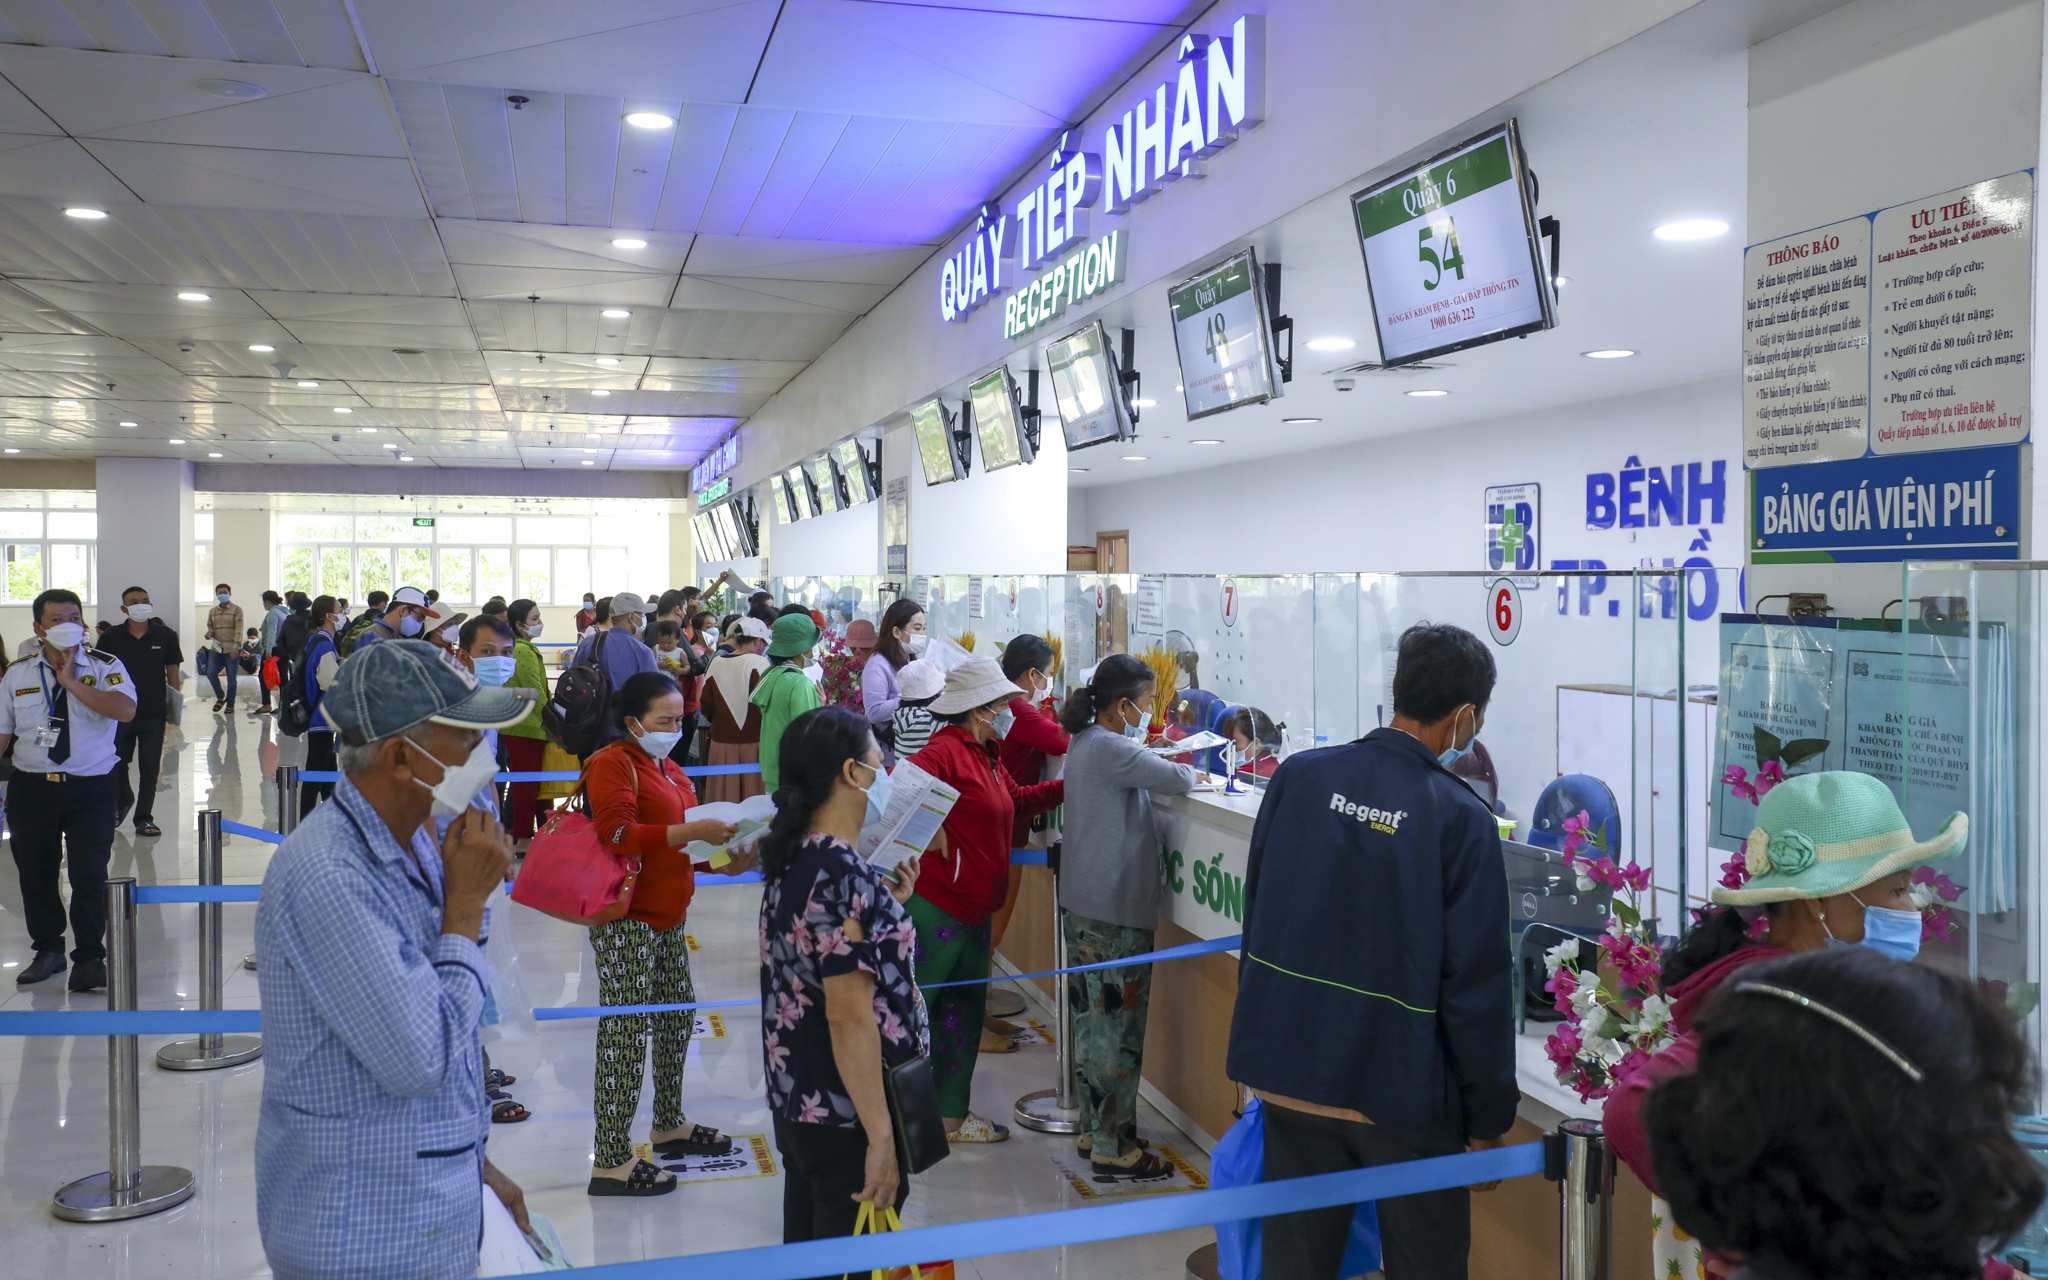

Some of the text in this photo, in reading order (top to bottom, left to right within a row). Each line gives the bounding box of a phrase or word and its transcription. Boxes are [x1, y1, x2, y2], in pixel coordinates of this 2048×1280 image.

[941, 14, 1246, 321] QUẦY TIẾP NHẬN
[1403, 169, 1457, 217] Quầy 6
[1911, 209, 1936, 229] ƯU
[1878, 253, 1894, 263] Luật
[1897, 249, 1918, 259] khám,
[1919, 243, 1938, 253] chữa
[1940, 236, 1958, 248] bệnh
[1961, 232, 1970, 243] số
[1909, 234, 1926, 244] Theo
[1929, 227, 1951, 239] khoản
[1954, 224, 1960, 233] 4,
[1419, 216, 1464, 291] 54
[1767, 235, 1839, 266] THÔNG BÁO
[1004, 230, 1118, 339] RECEPTION
[1892, 261, 1984, 288] Trường hợp cấp cứu;
[1195, 277, 1223, 310] Quầy 7
[1414, 303, 1432, 318] KHÁM
[1432, 298, 1450, 313] BỆNH
[1482, 281, 1506, 297] THÔNG
[1507, 277, 1520, 289] TIN
[1892, 284, 1976, 311] Trẻ em dưới 6 tuổi;
[1430, 306, 1476, 330] 1900 636 223
[1892, 309, 1994, 336] Người khuyết tật nặng;
[1206, 312, 1230, 364] 48
[1891, 330, 2013, 359] Người từ đủ 80 tuổi trở lên;
[1891, 354, 2025, 382] Người có công với cách mạng;
[1891, 386, 1956, 404] Phụ nữ có thai.
[1902, 400, 1995, 422] Trường hợp ưu tiên liên hệ
[1878, 413, 2022, 442] Quầy tiếp nhận số 1, 6, 10 để được hỗ trợ
[1586, 455, 1726, 542] BỆNH
[1764, 469, 1996, 540] BẢNG GIÁ VIỆN PHÍ
[1551, 529, 1720, 622] TP. HỒ
[1097, 587, 1103, 609] 8
[1224, 586, 1234, 617] 7
[1496, 589, 1512, 631] 6
[1858, 723, 1885, 734] KHÁM
[1941, 732, 1963, 744] BỆNH
[1919, 715, 1937, 728] GIÁ
[1850, 746, 1879, 758] THANH
[1947, 761, 1969, 771] BHYT
[1859, 734, 1961, 757] KHÔNG PHẠM VI
[1859, 759, 1882, 770] THEO
[1330, 792, 1403, 829] Regent
[1370, 821, 1396, 835] ENERGY
